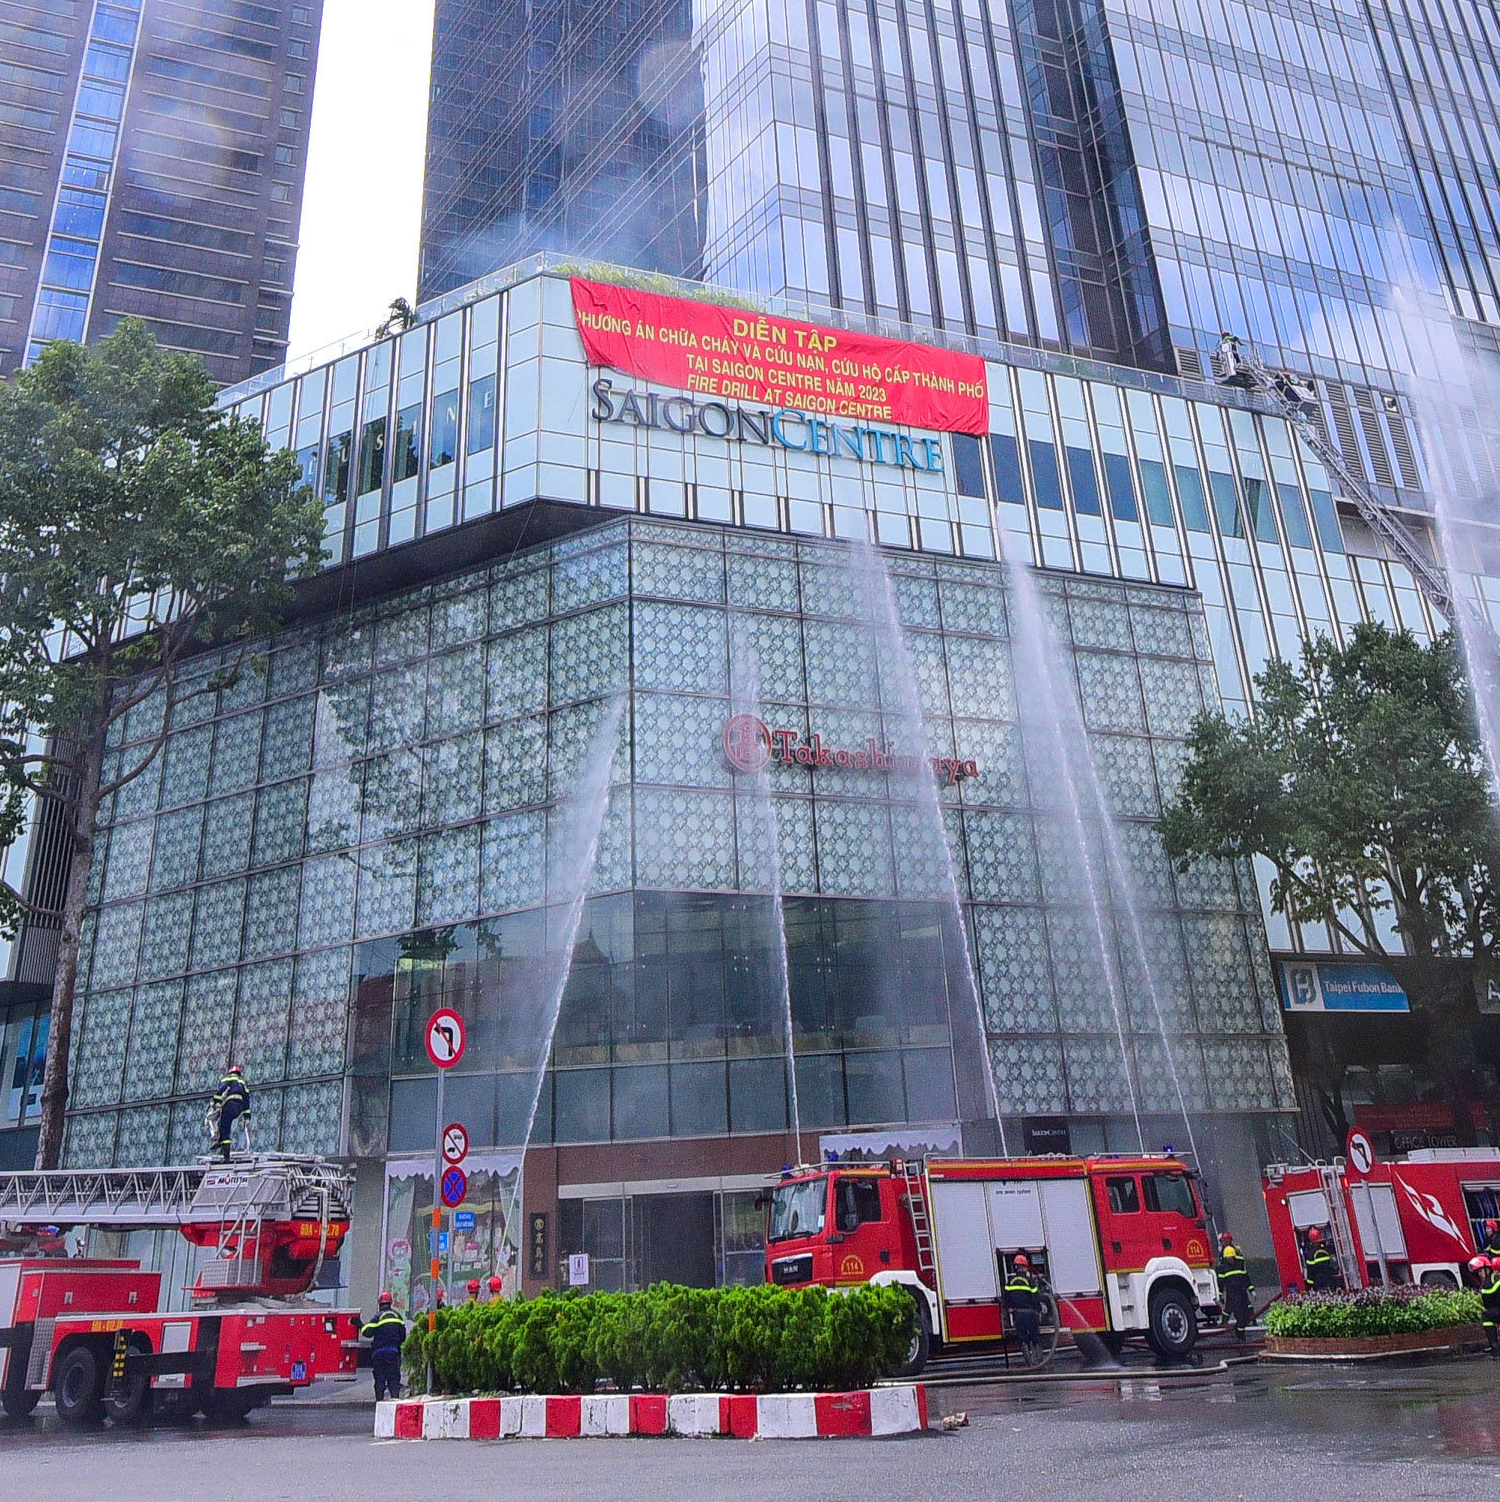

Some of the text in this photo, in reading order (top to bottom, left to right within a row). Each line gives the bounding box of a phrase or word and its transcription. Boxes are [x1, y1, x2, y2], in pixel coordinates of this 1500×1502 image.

[733, 316, 838, 354] DIỄN TẬP
[635, 319, 655, 341] ÁN
[659, 327, 698, 348] CHỮA
[701, 334, 739, 356] CHÁY
[743, 341, 762, 360] VÀ
[765, 344, 793, 366] CỨU
[797, 353, 829, 374] NẠN,
[832, 357, 859, 378] CỨU
[863, 363, 882, 382] HỘ
[884, 364, 911, 384] CẤP
[912, 366, 955, 394] THÀNH
[958, 379, 985, 399] PHỐ
[686, 353, 886, 403] TẠI SAIGON CENTRE NĂM 2023
[687, 374, 892, 420] FIRE DRILL AT SAIGON CENTRE
[774, 729, 979, 785] Takashimaya
[1324, 980, 1404, 994] Taipei Fubon Bank
[1394, 1135, 1458, 1149] OFFICE TOWER
[783, 1264, 799, 1274] MAN
[846, 1261, 859, 1270] 114
